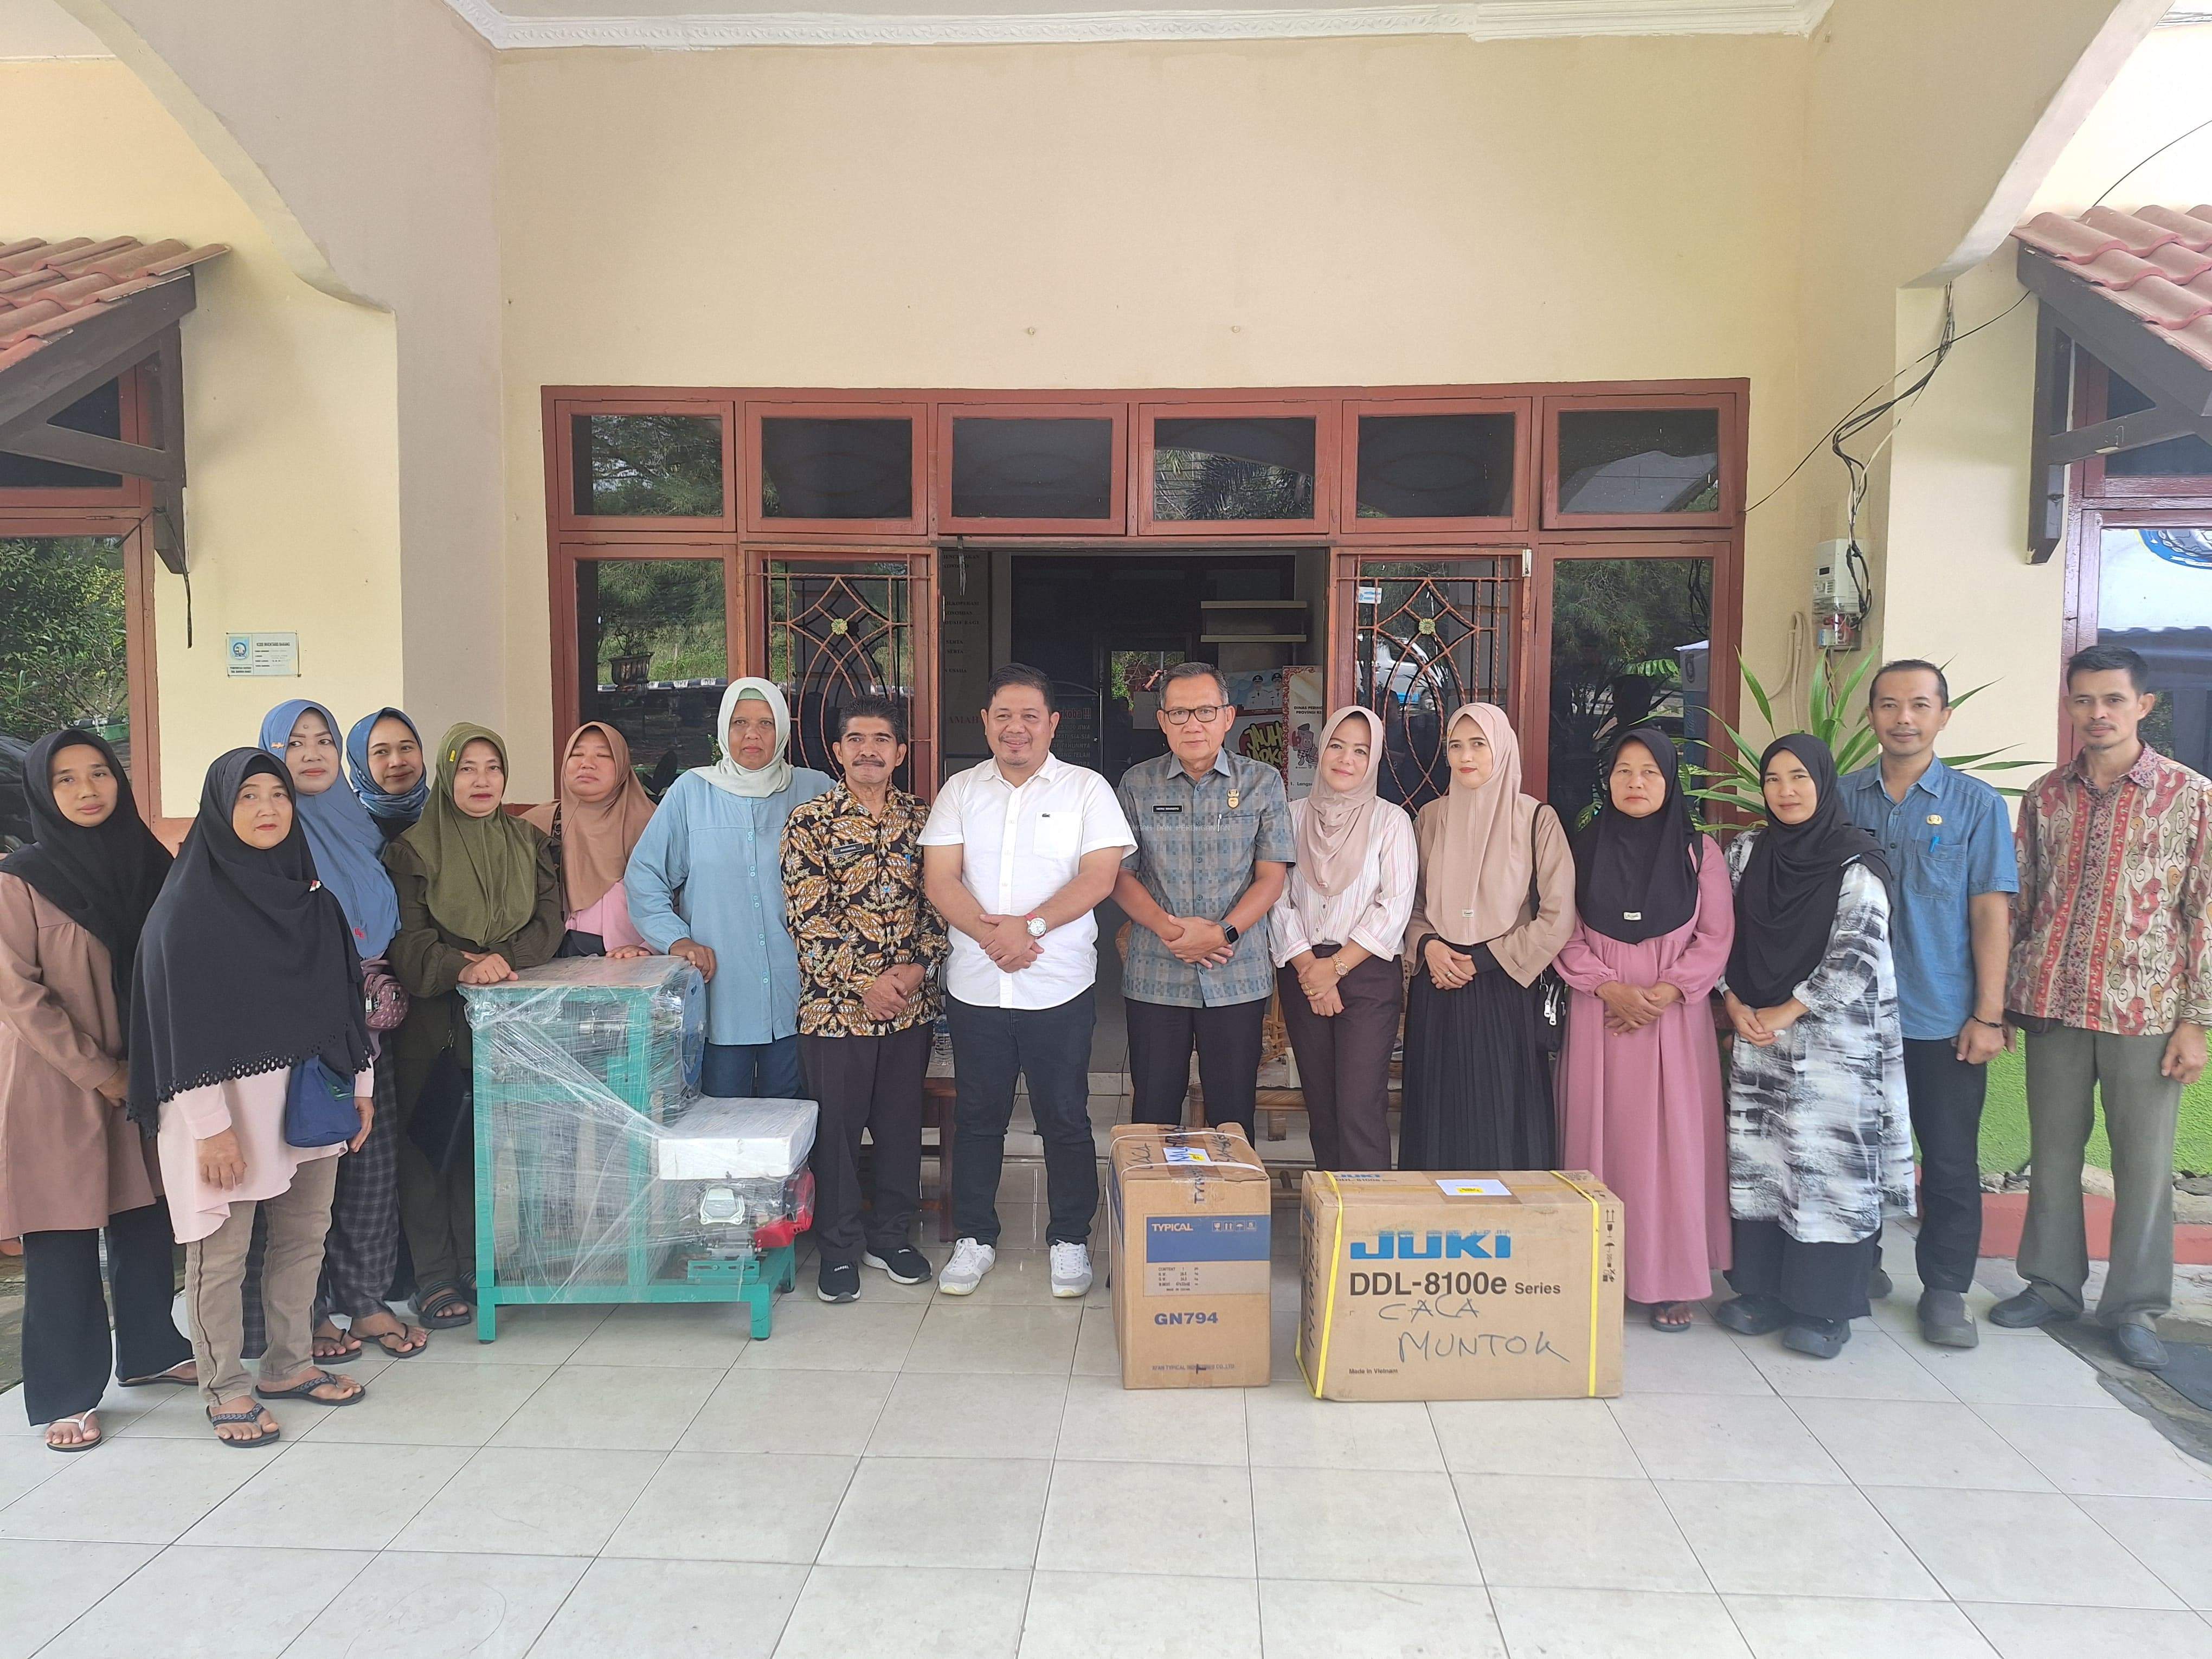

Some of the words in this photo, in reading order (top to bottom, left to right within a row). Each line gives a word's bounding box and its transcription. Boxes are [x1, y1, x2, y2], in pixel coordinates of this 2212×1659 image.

[1152, 1223, 1193, 1232] TYPICAL
[1350, 1229, 1511, 1259] JUKI
[1349, 1271, 1507, 1296] DDL-8100e
[1515, 1282, 1561, 1295] Series
[1154, 1312, 1218, 1325] GN794
[1379, 1294, 1479, 1322] CACA
[1399, 1330, 1570, 1363] MUNTOK
